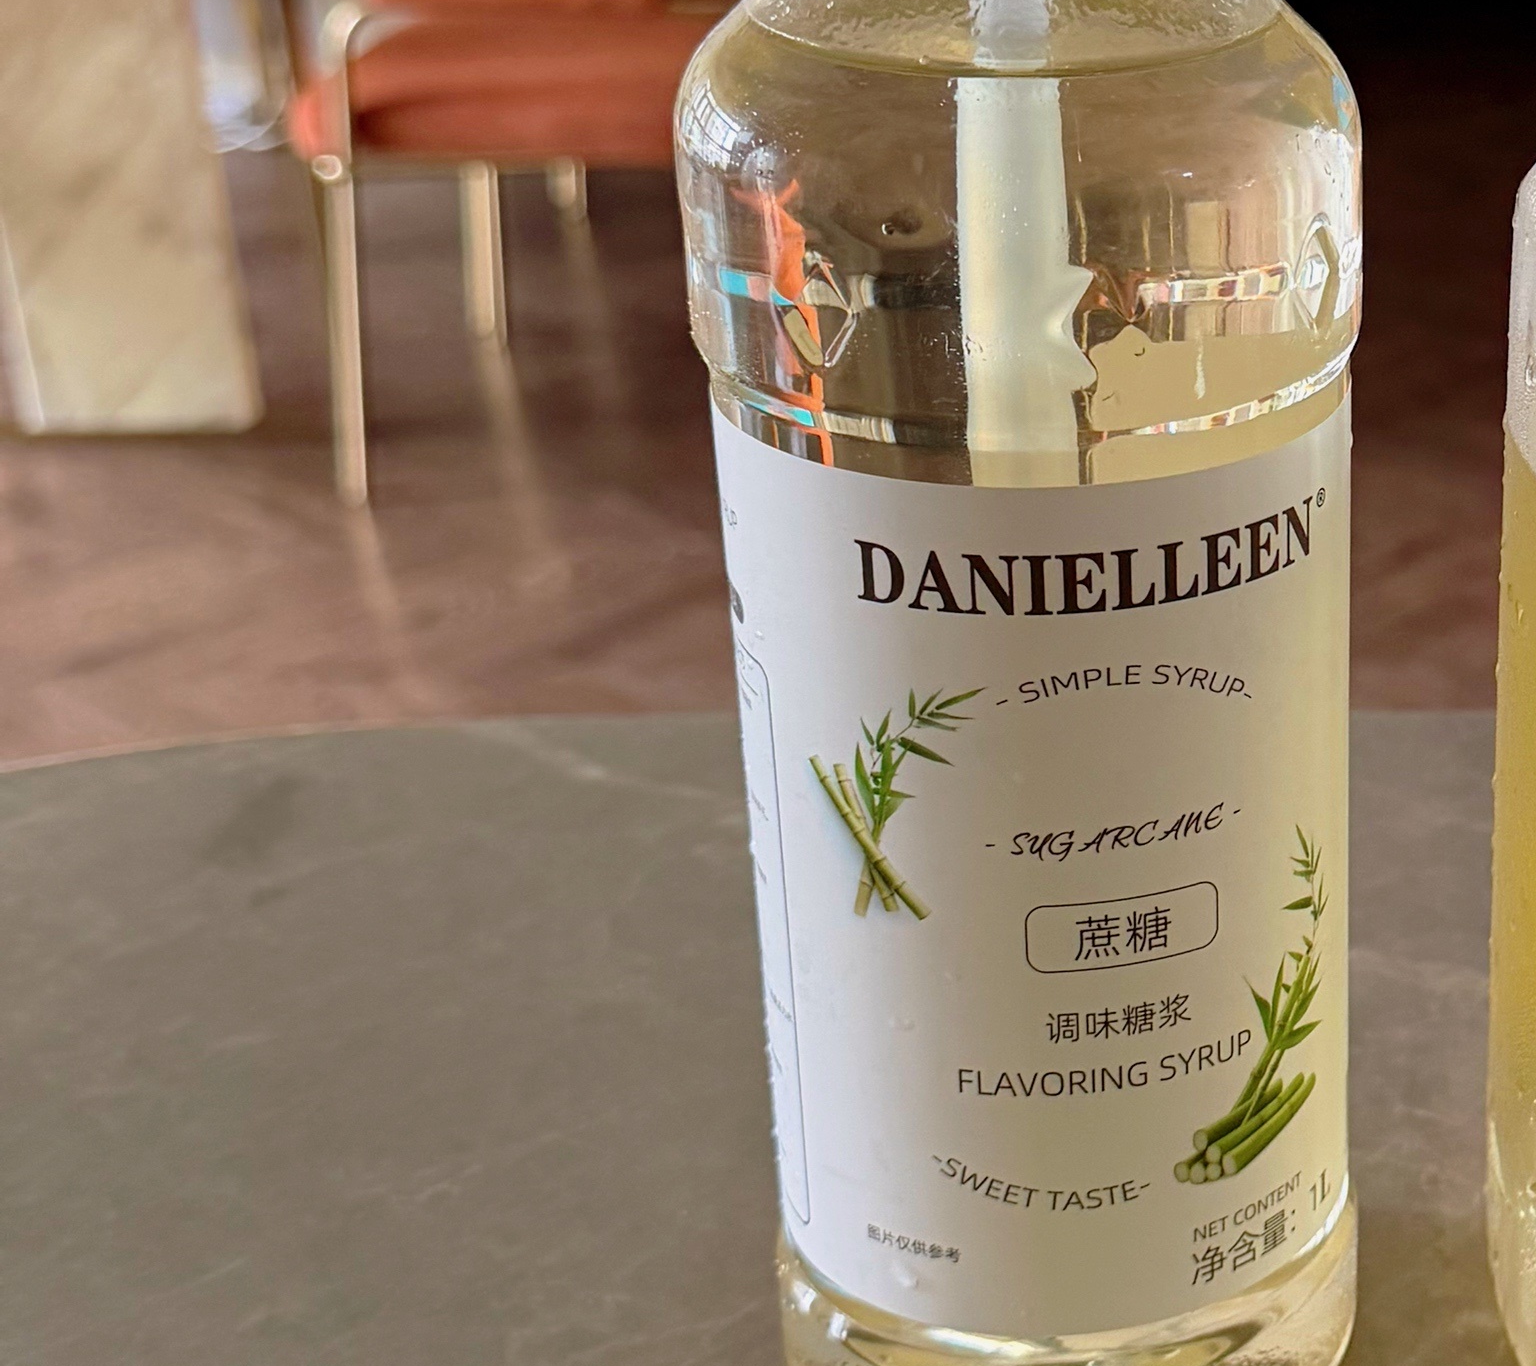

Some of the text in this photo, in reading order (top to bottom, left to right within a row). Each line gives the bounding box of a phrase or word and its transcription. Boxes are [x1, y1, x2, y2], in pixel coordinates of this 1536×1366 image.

[1018, 665, 1142, 704] SIMPLE
[1074, 906, 1173, 962] 蔗糖
[1046, 993, 1192, 1044] 调味糖浆
[957, 1029, 1252, 1097] FLAVORING SYRUP
[1193, 1171, 1302, 1243] NET CONTENT
[1309, 1169, 1331, 1211] 1L
[866, 1223, 962, 1263] 图片仅供参考
